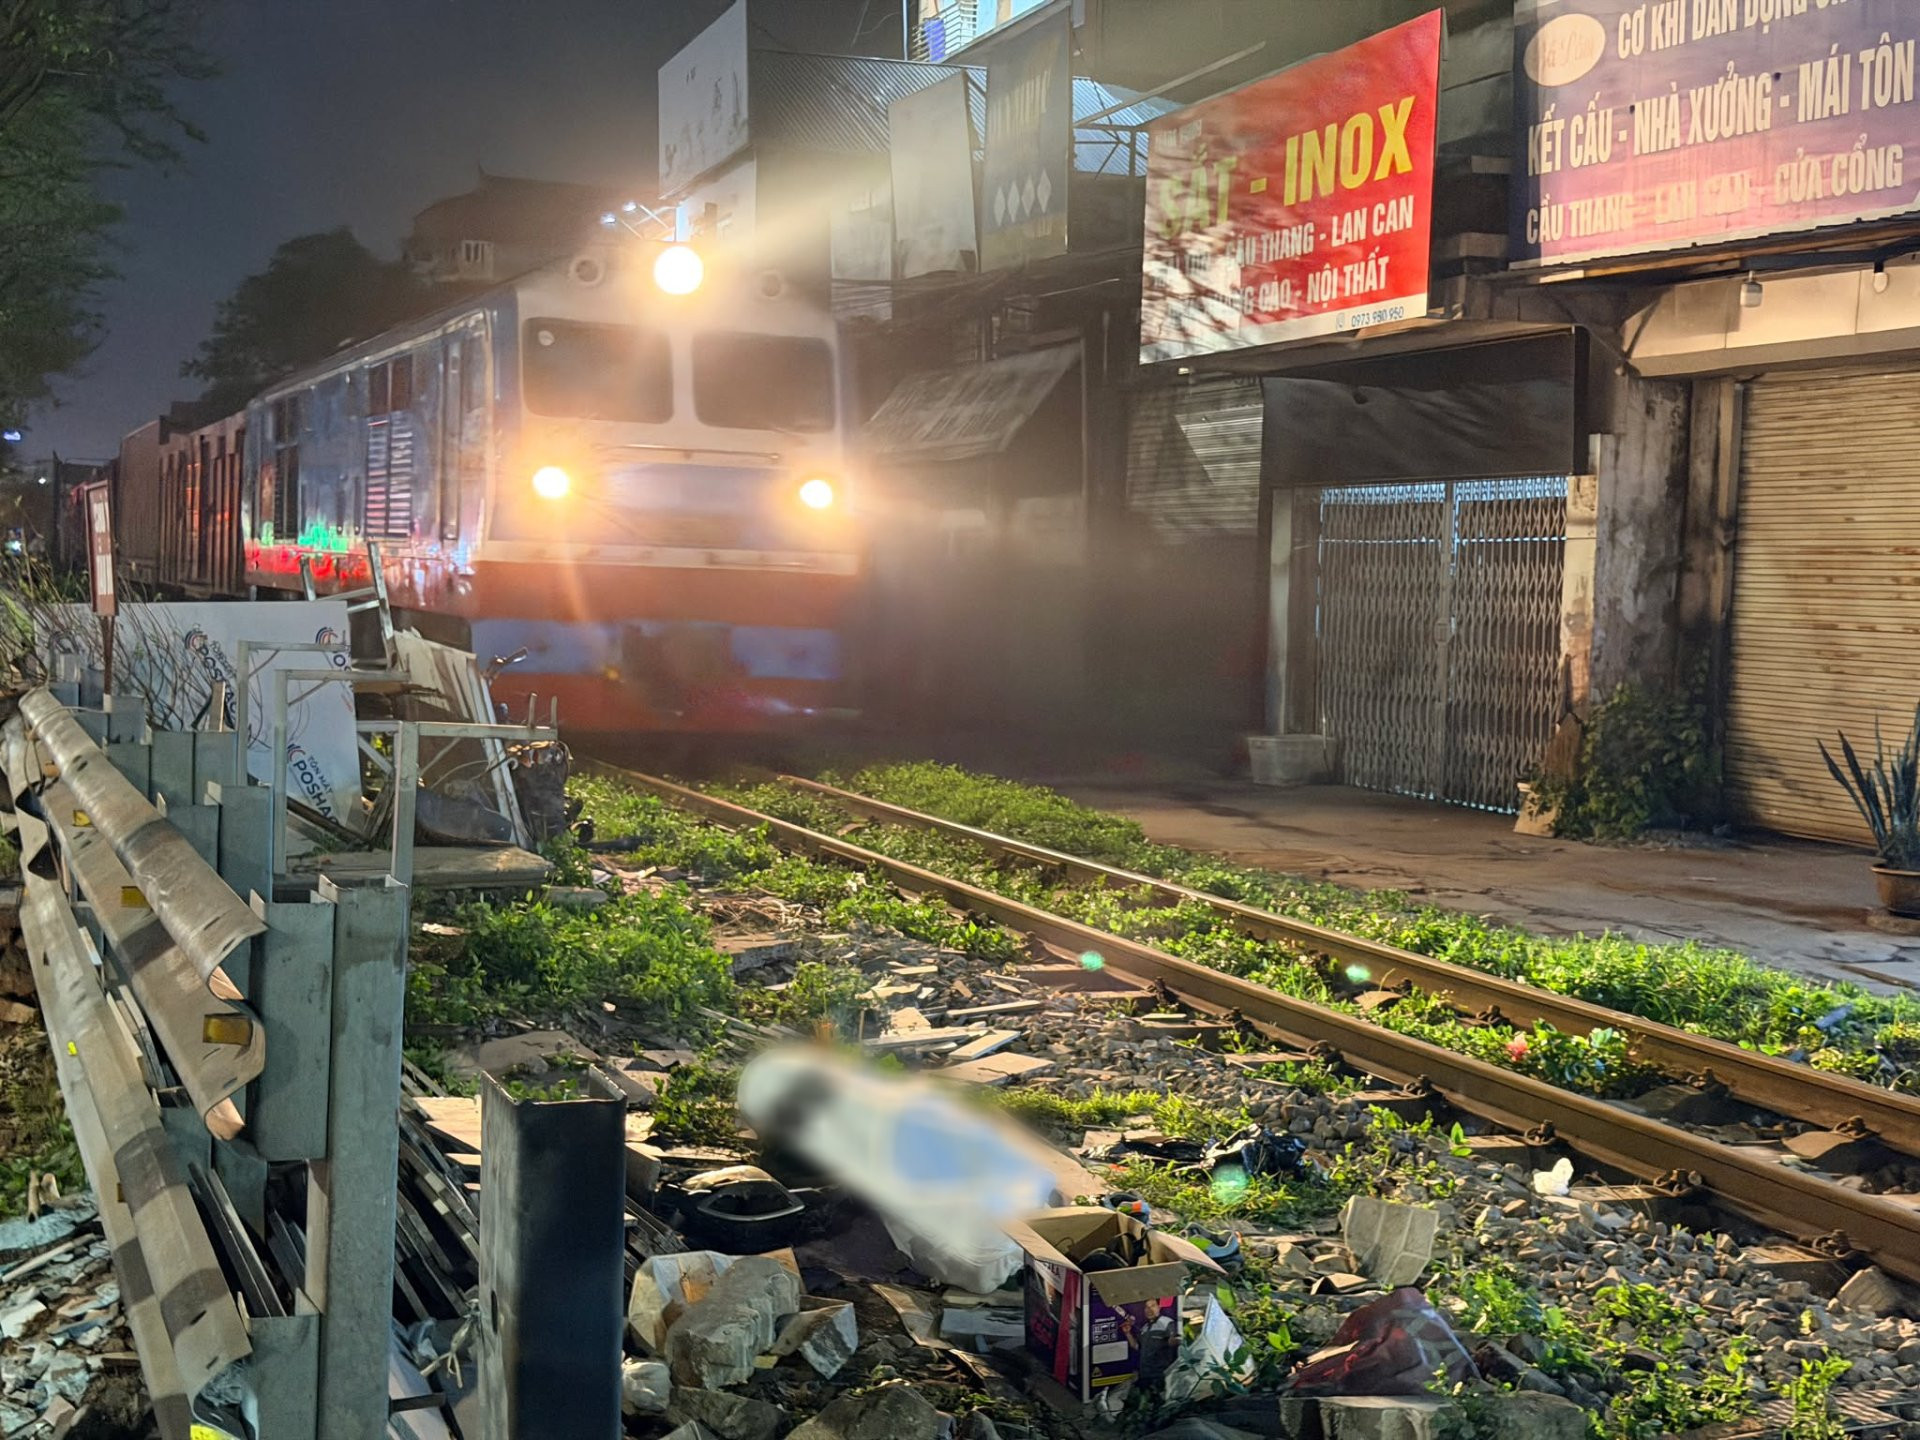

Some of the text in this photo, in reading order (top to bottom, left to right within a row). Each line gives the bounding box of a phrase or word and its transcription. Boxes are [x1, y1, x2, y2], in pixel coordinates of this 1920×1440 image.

[1617, 4, 1646, 60] CƠ
[1528, 103, 1565, 176] KẾT
[1569, 92, 1613, 167] CẤU
[1634, 80, 1681, 156] NHÀ
[1687, 61, 1773, 145] XƯỞNG
[1797, 43, 1851, 122] MÁI
[1858, 32, 1916, 111] TÔN
[1283, 96, 1415, 206] INOX
[1526, 193, 1563, 245] CẦU
[1569, 193, 1634, 238] THANG
[1831, 133, 1904, 197] CỔNG
[1331, 207, 1367, 248] LAN
[1372, 195, 1415, 237] CAN
[1307, 263, 1339, 308] NỘI
[1344, 246, 1389, 297] THẤT
